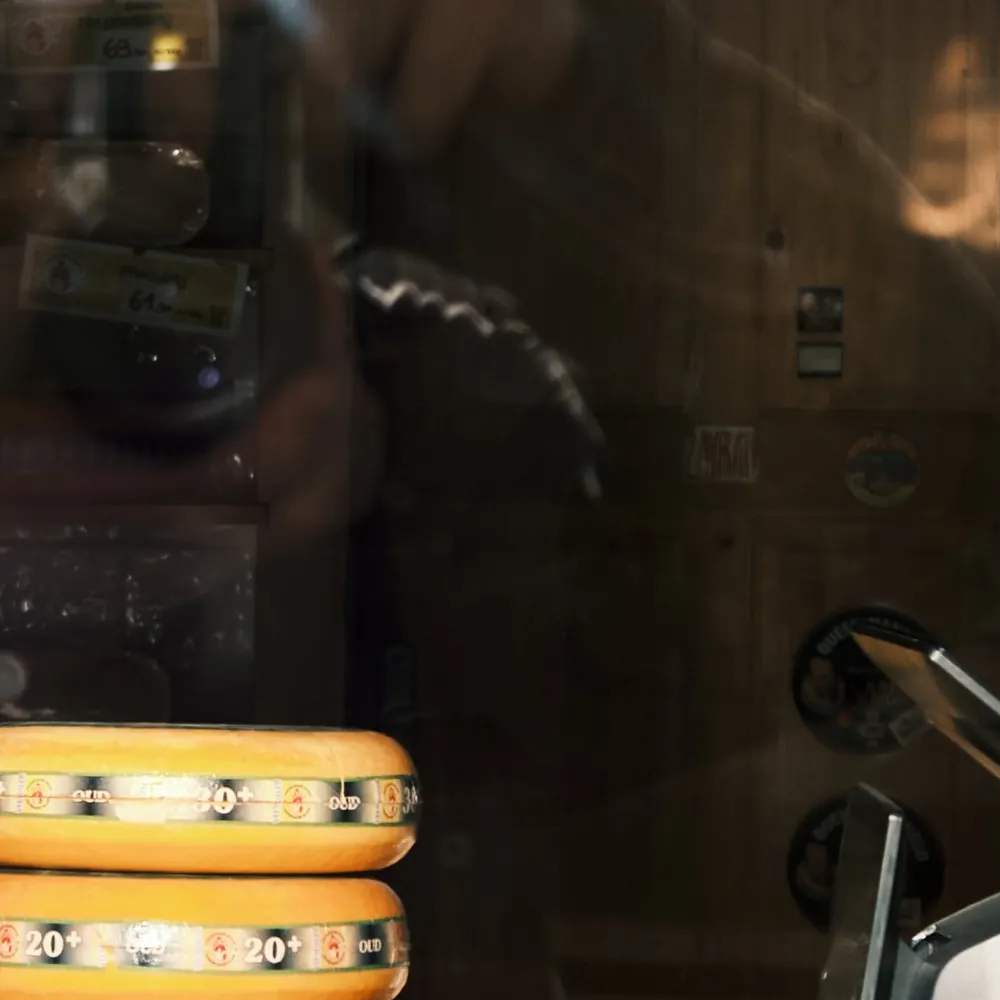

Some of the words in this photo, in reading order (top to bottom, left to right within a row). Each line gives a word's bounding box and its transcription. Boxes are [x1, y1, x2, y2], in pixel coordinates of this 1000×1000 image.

[72, 790, 111, 804] OUD
[329, 796, 361, 810] OUD
[25, 930, 82, 957] 20+
[244, 935, 302, 964] 20+
[358, 938, 382, 953] OUD
